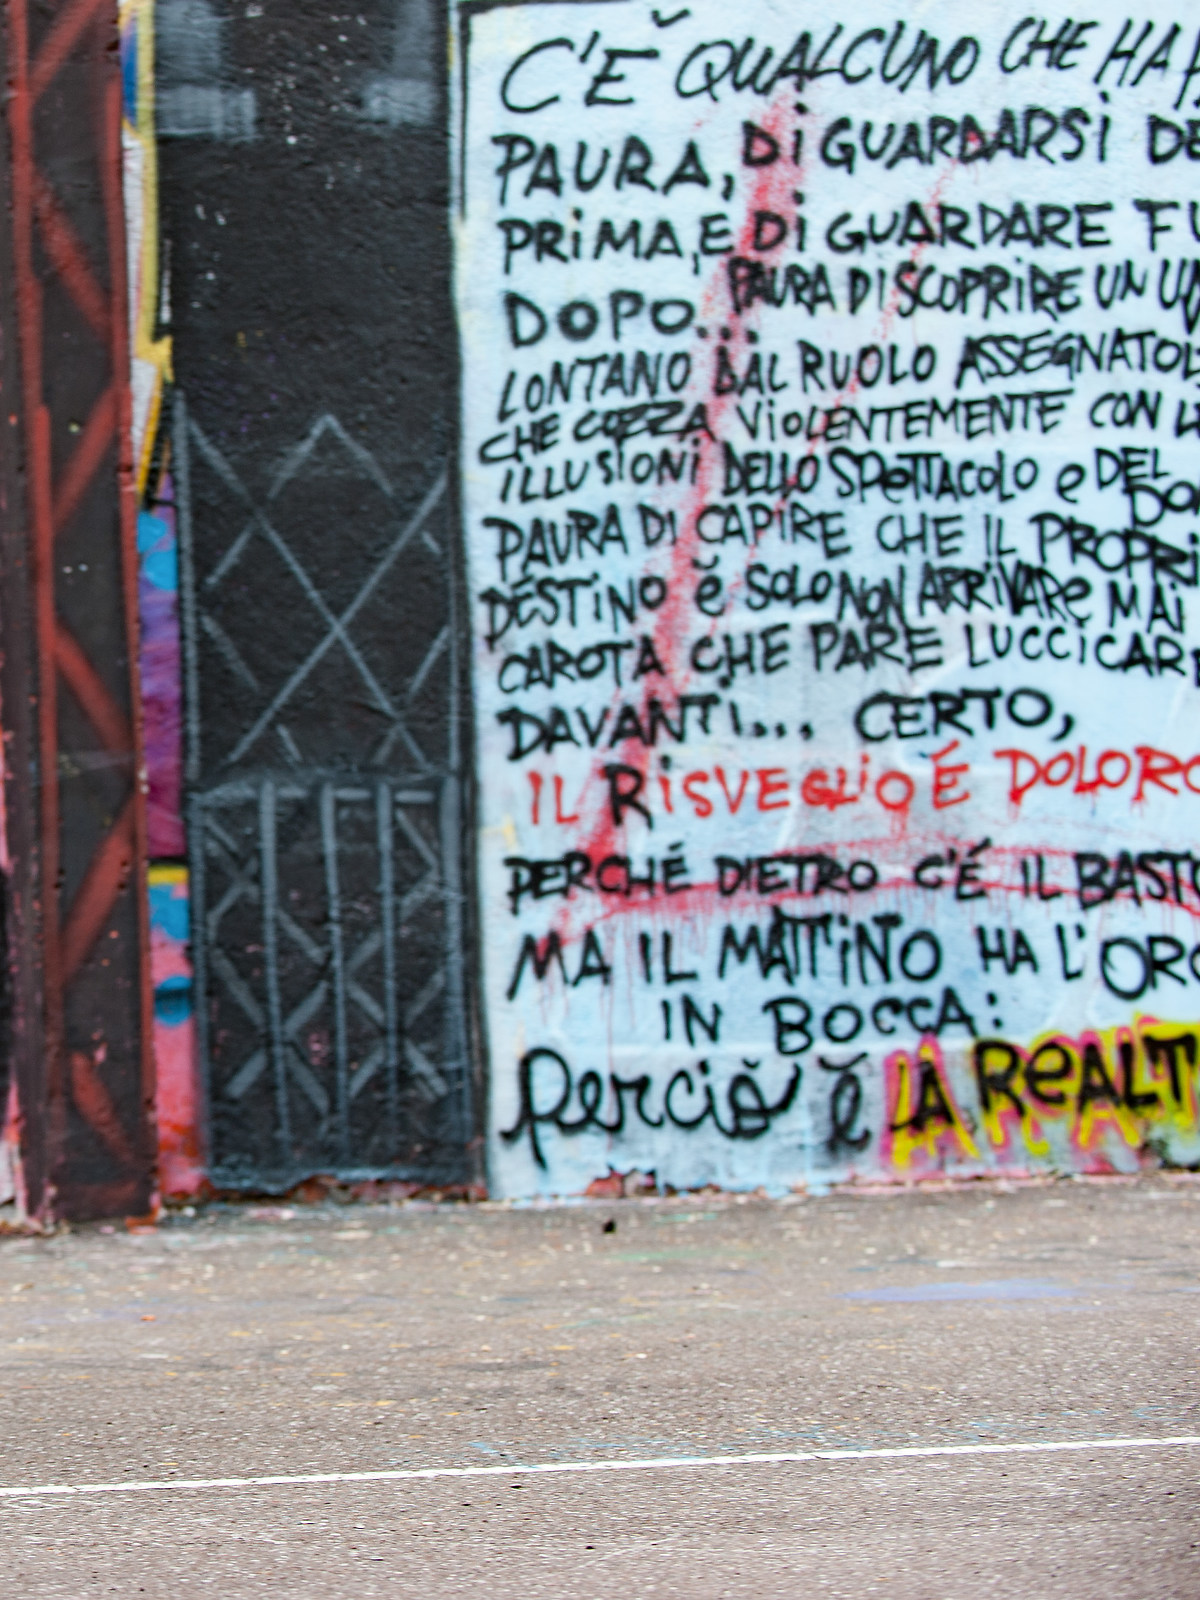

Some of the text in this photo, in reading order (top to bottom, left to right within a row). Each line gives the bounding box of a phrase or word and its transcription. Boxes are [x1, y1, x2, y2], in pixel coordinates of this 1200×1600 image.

[675, 20, 981, 103] QUALCUNO
[999, 17, 1100, 75] CHE
[1093, 17, 1182, 87] HA
[491, 134, 735, 207] PAURA,
[825, 200, 1114, 255] GUARDARE
[727, 256, 837, 317] PAURA
[1094, 258, 1148, 310] UN
[497, 327, 1200, 424] LONTANO DAL RUOLO ASSEGNATOL
[478, 412, 560, 465] CHE
[1089, 388, 1163, 431] CON
[722, 441, 820, 500] DELLO
[1094, 446, 1171, 491] DEL
[1121, 480, 1200, 529] DO
[482, 503, 629, 582] PAURA
[876, 512, 965, 558] CHE
[499, 616, 1200, 694] CAROTA CHE PARE LUCCiCAR
[855, 687, 1076, 742] CERTO,
[527, 769, 580, 826] IL
[714, 851, 878, 897] DIETRO
[1020, 852, 1061, 901] IL
[506, 928, 612, 1002] MA
[640, 930, 698, 985] IL
[975, 925, 1039, 976] HA
[661, 986, 1004, 1056] IN BOCCA:
